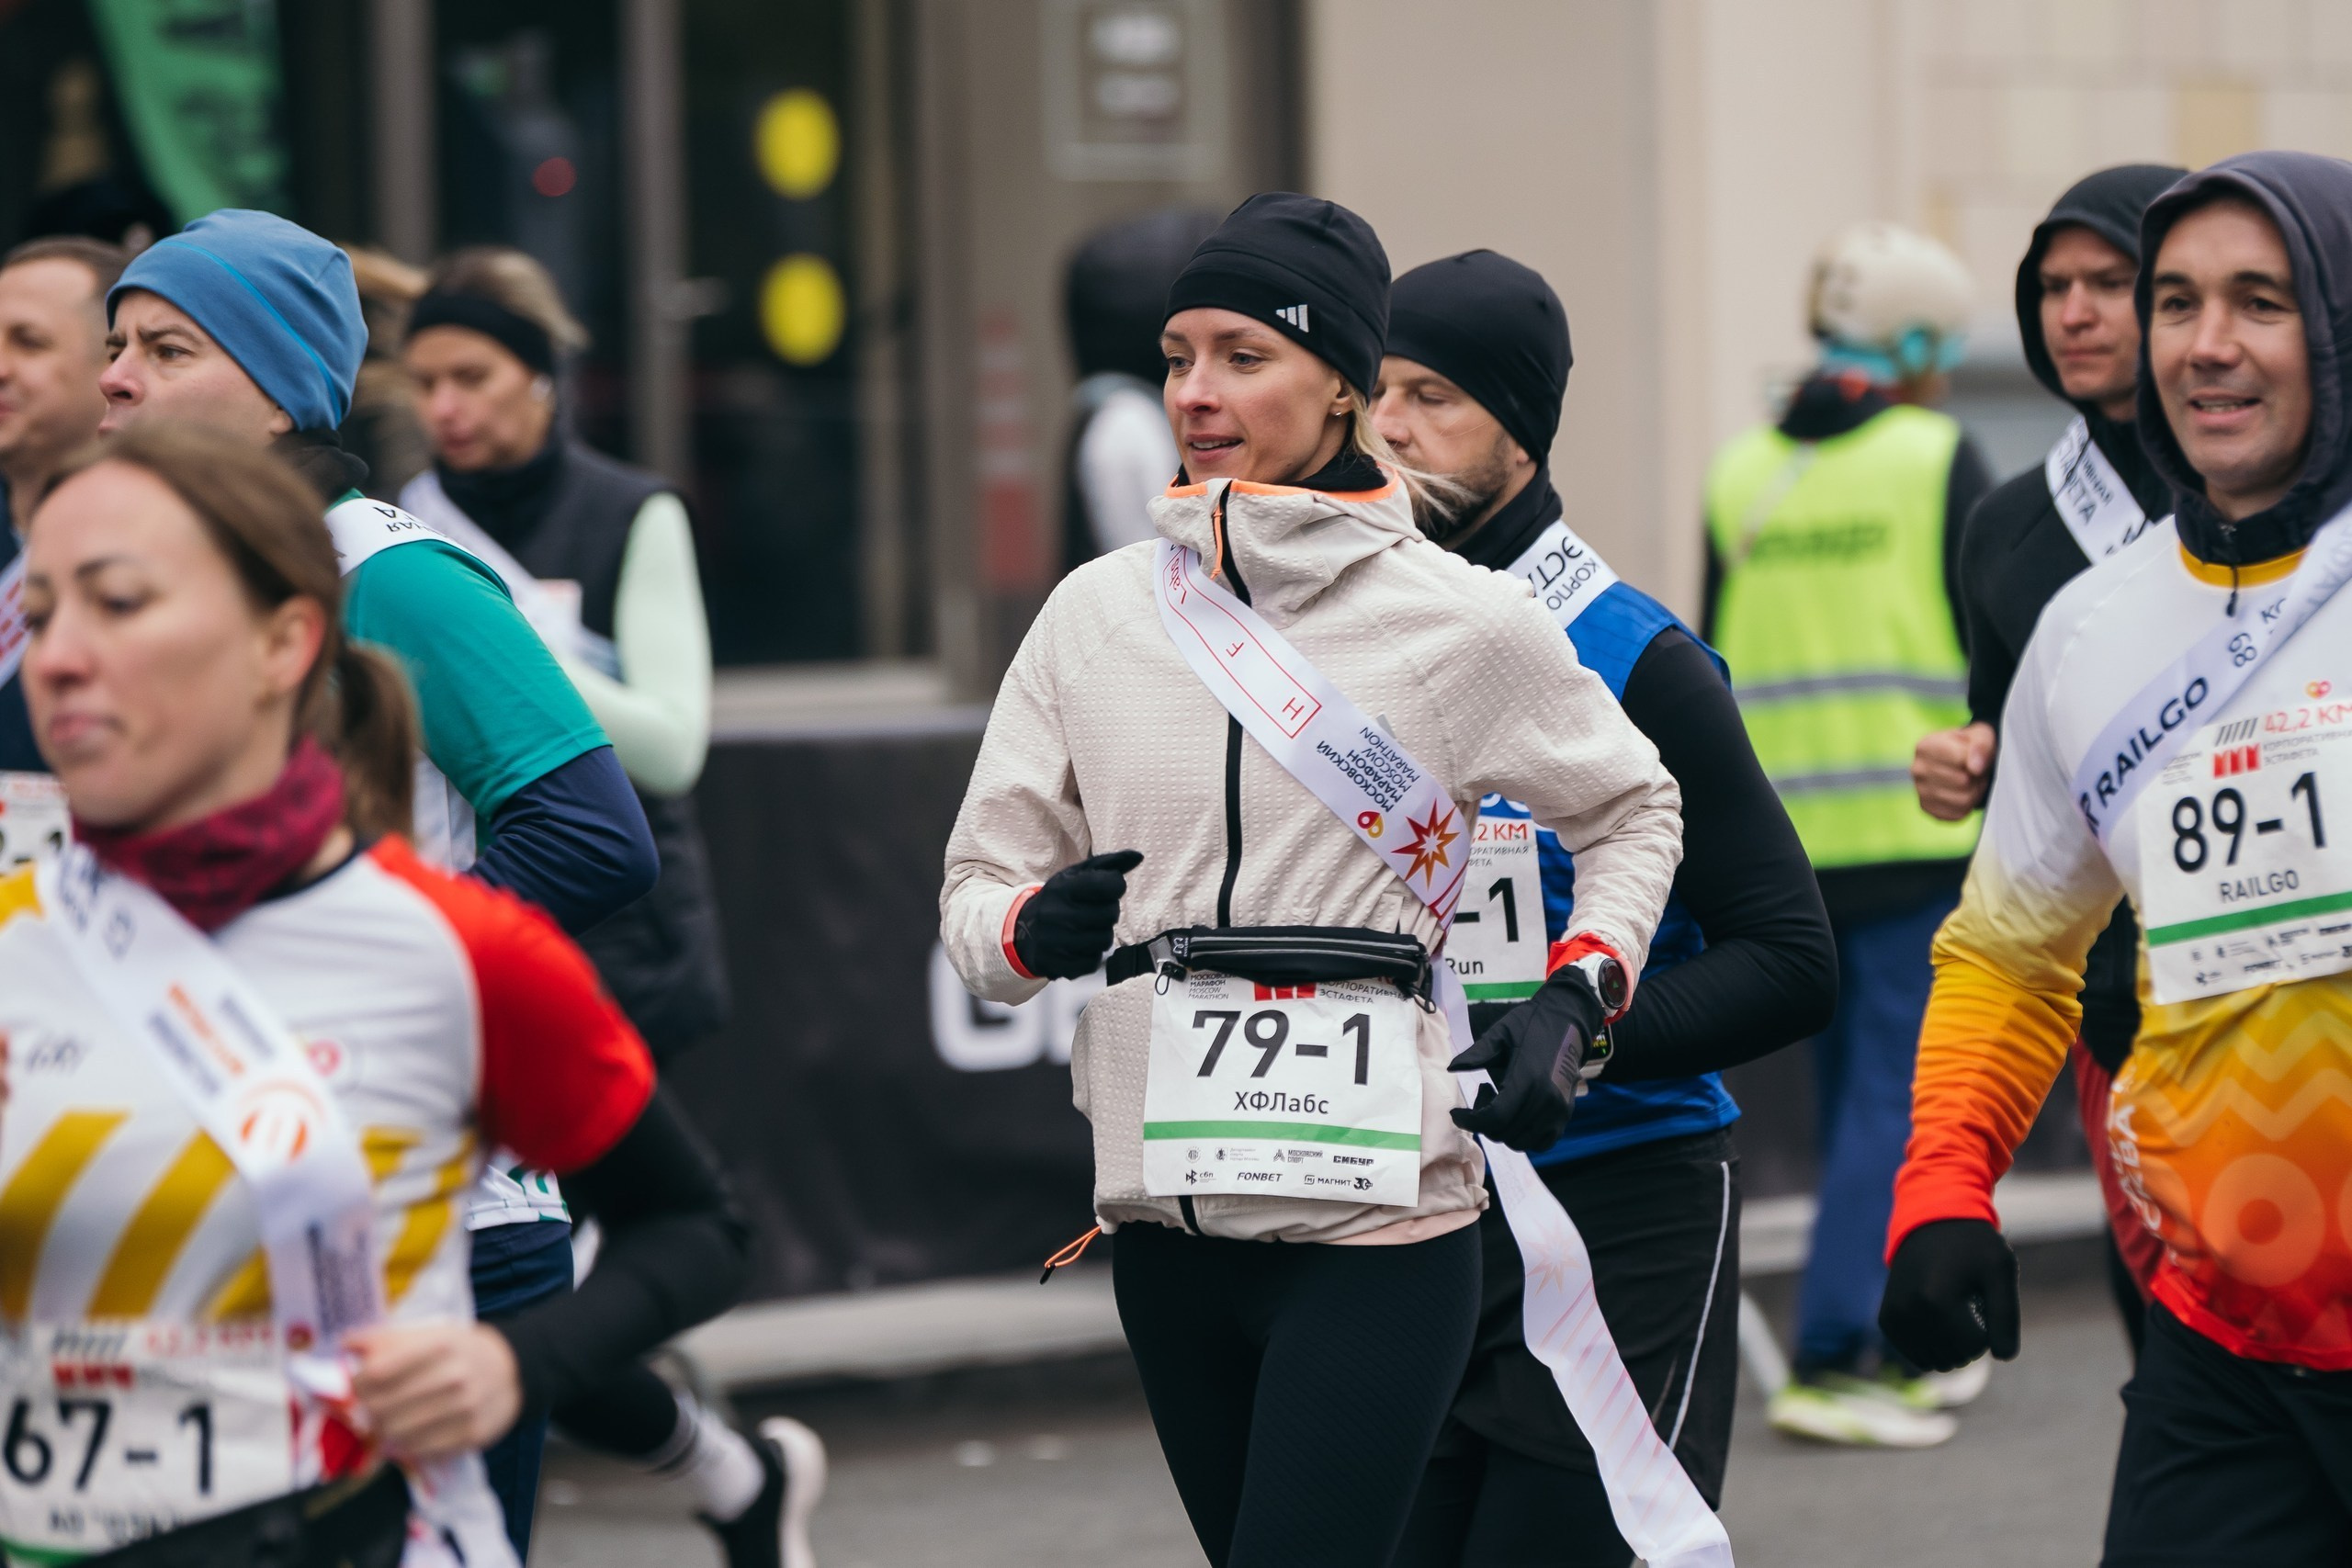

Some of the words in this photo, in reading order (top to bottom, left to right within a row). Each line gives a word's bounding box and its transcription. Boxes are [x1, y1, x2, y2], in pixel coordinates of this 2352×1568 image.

[2264, 708, 2314, 734] 42,2
[1359, 727, 1420, 783] MARATHON
[2094, 676, 2210, 809] RAILGO
[1317, 740, 1395, 813] МОСКОВСКИЙ
[1347, 750, 1404, 803] МАРАФОН
[1361, 748, 1412, 793] MOSCOW
[1493, 822, 1528, 840] КМ
[2171, 772, 2328, 875] 89-1
[2220, 869, 2300, 904] RAILGO
[1319, 988, 1374, 1004] ЭСТАФЕТА
[1192, 1009, 1371, 1087] 79-1
[1233, 1090, 1330, 1115] ХФЛабс
[1237, 1171, 1283, 1182] FONBET
[1333, 1155, 1374, 1167] СИБУР
[1317, 1177, 1351, 1187] МАГНИТ
[3, 1397, 214, 1495] 67-1
